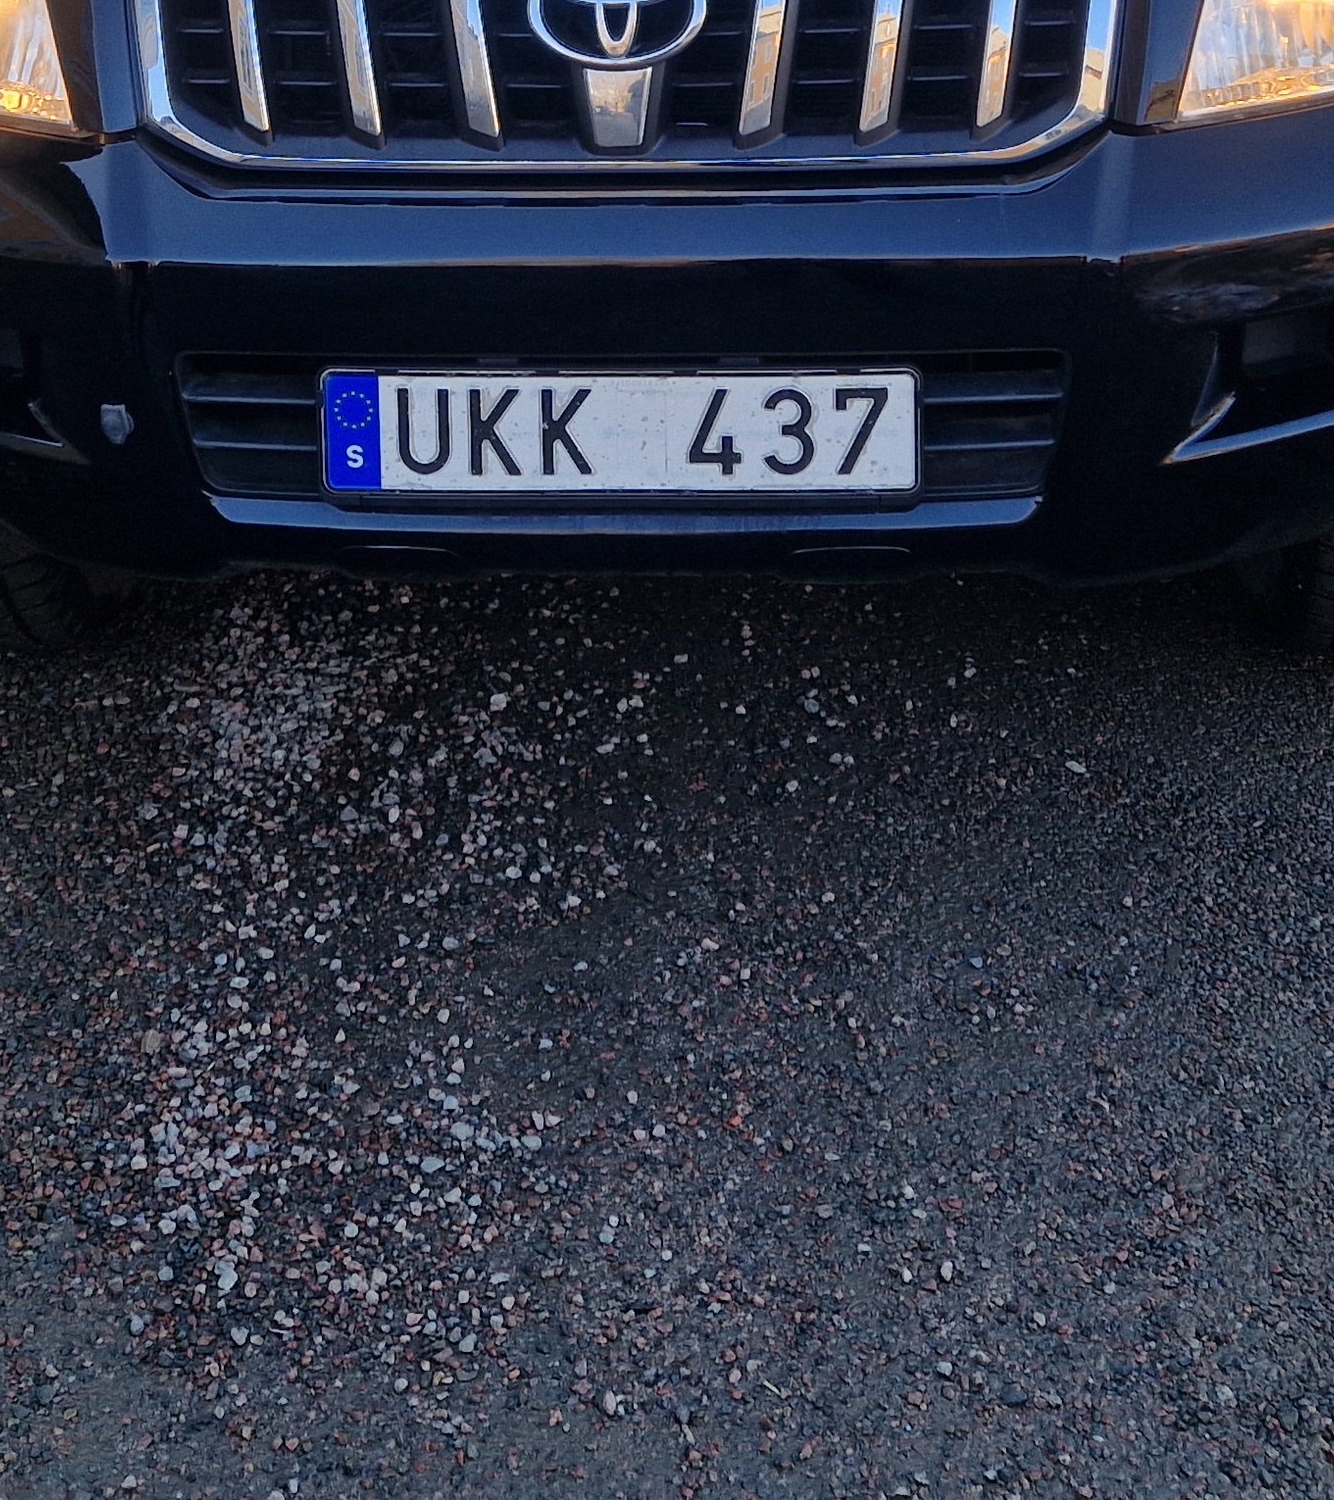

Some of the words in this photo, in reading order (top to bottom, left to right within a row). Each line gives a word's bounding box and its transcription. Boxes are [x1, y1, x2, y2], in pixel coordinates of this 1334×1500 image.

[346, 444, 364, 469] S
[397, 388, 592, 475] UKK
[689, 387, 888, 475] 437
